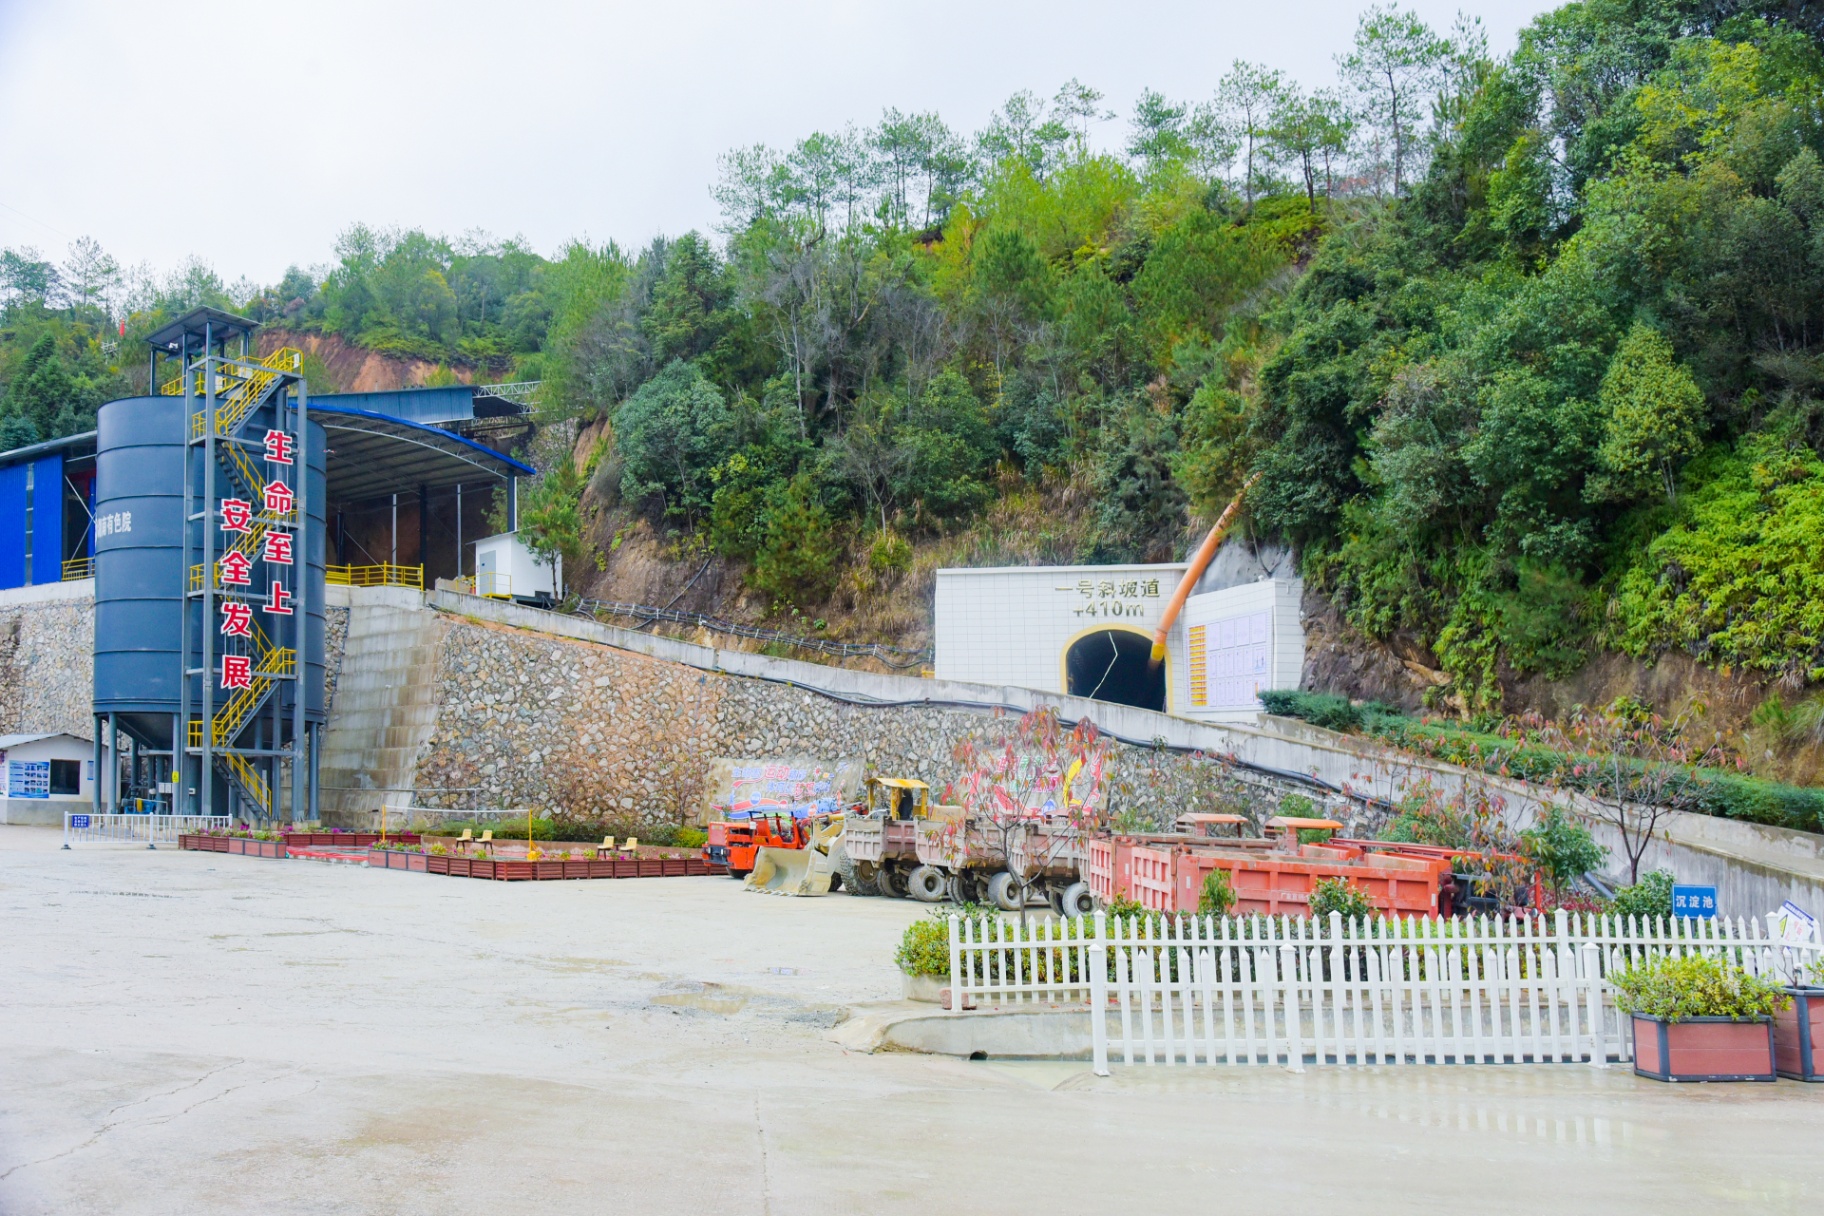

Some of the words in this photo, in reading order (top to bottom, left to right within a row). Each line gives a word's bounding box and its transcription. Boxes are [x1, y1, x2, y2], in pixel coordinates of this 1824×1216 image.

[263, 429, 293, 615] 生命至上
[220, 498, 251, 690] 安全发展
[1055, 578, 1160, 599] 一号斜坡道
[1073, 600, 1144, 617] +410m
[1675, 894, 1715, 909] 沉淀池
